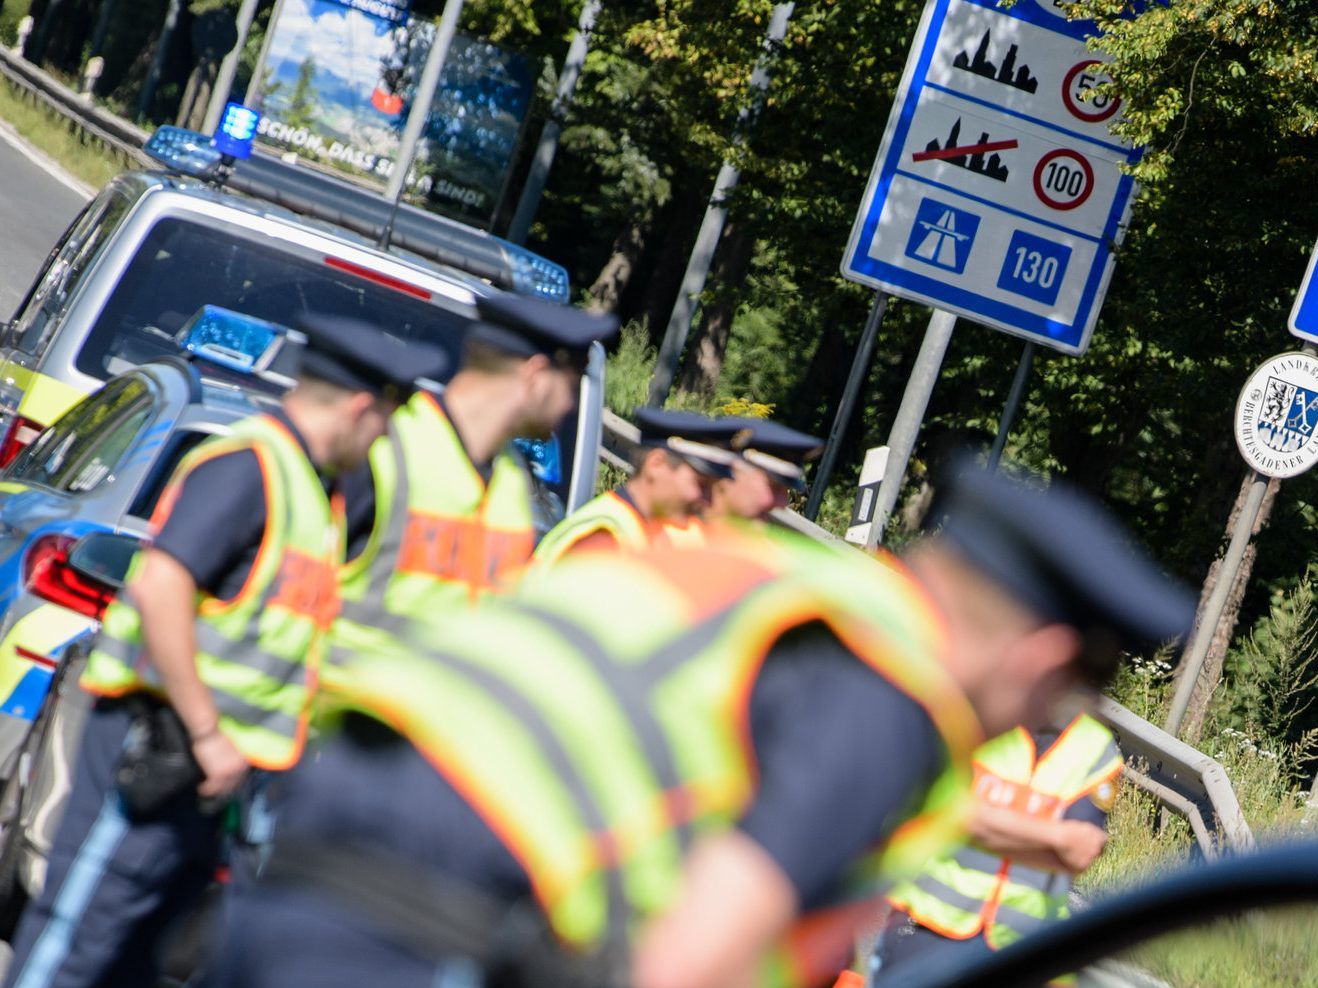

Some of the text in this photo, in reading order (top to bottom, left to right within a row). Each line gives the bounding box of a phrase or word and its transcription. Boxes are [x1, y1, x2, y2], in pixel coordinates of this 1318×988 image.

[329, 141, 376, 171] DASS
[1048, 162, 1083, 197] 100
[1013, 247, 1059, 288] 130
[1243, 401, 1303, 470] BERCHTESGADENER
